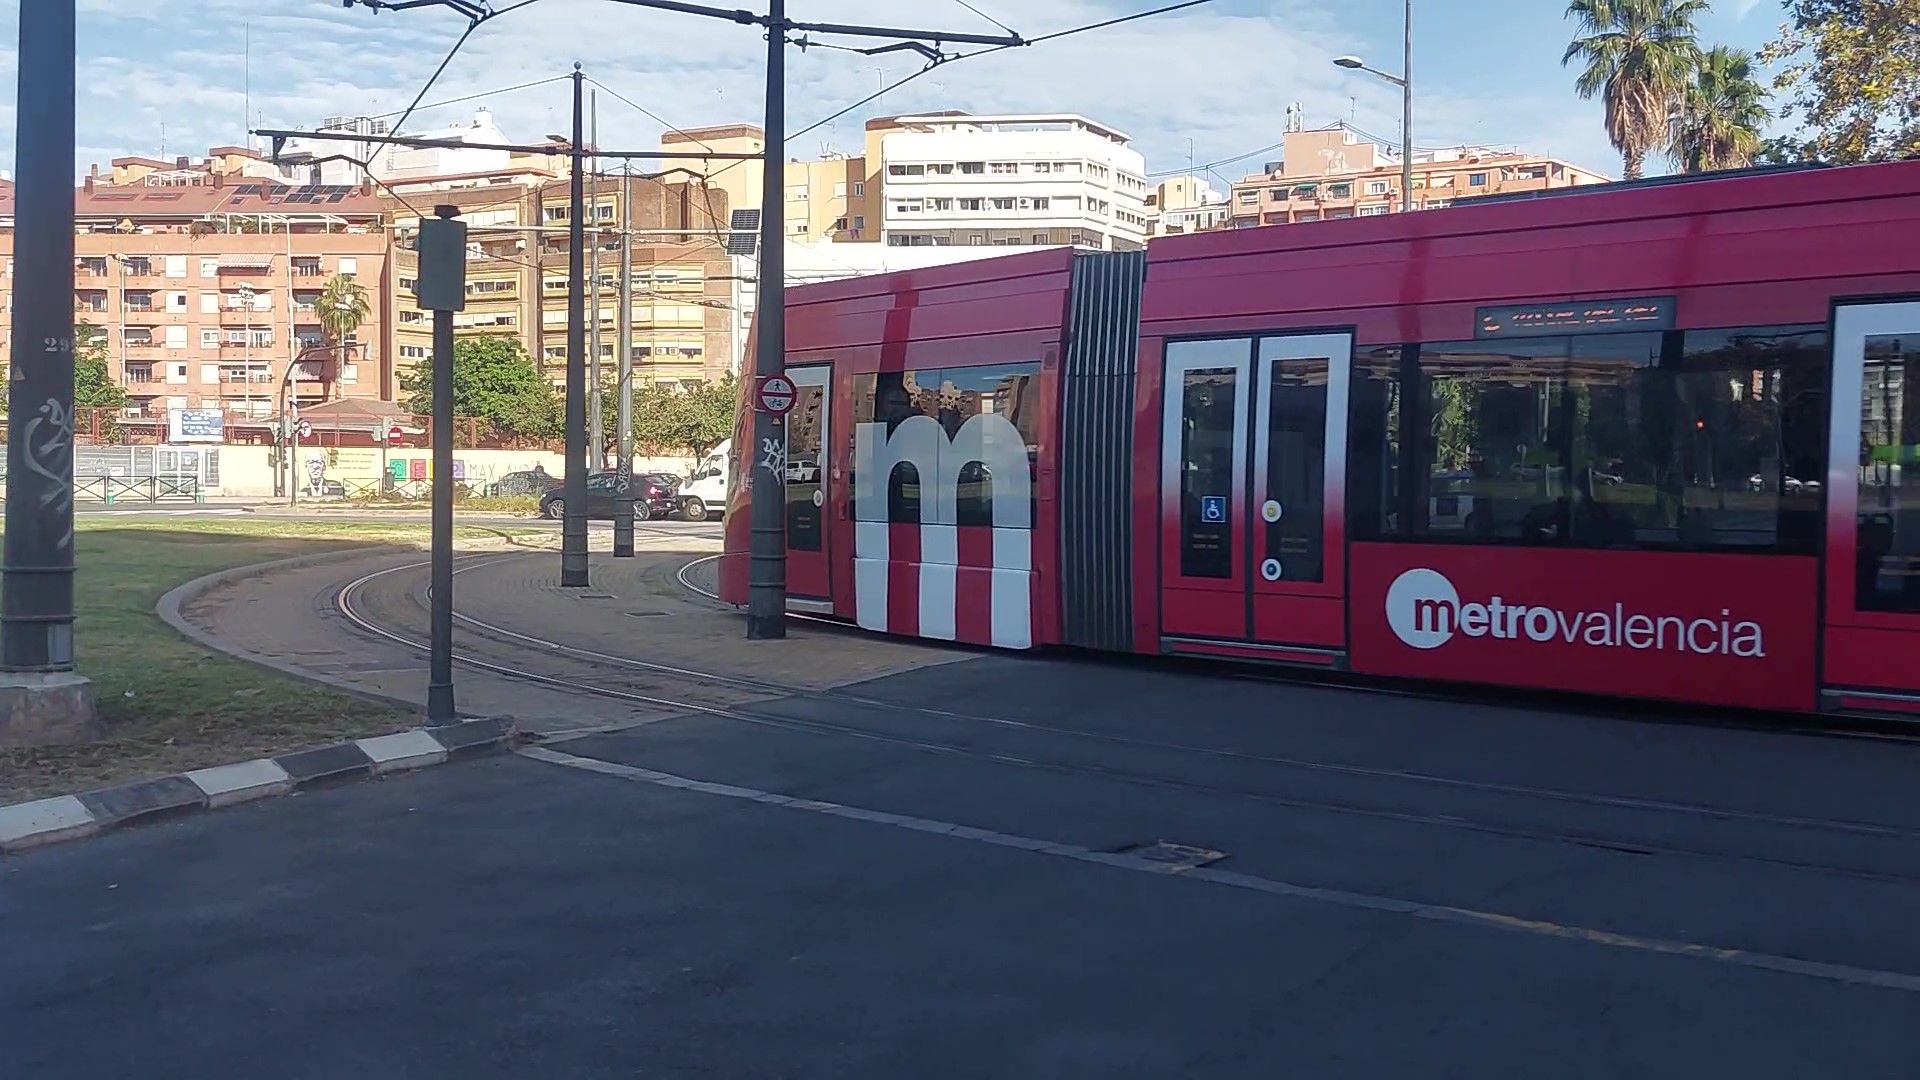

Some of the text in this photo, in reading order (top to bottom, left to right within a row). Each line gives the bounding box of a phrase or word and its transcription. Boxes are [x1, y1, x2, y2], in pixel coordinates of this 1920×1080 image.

[469, 463, 496, 480] MAX
[855, 413, 1032, 649] m
[1413, 596, 1766, 657] metrovalencia
